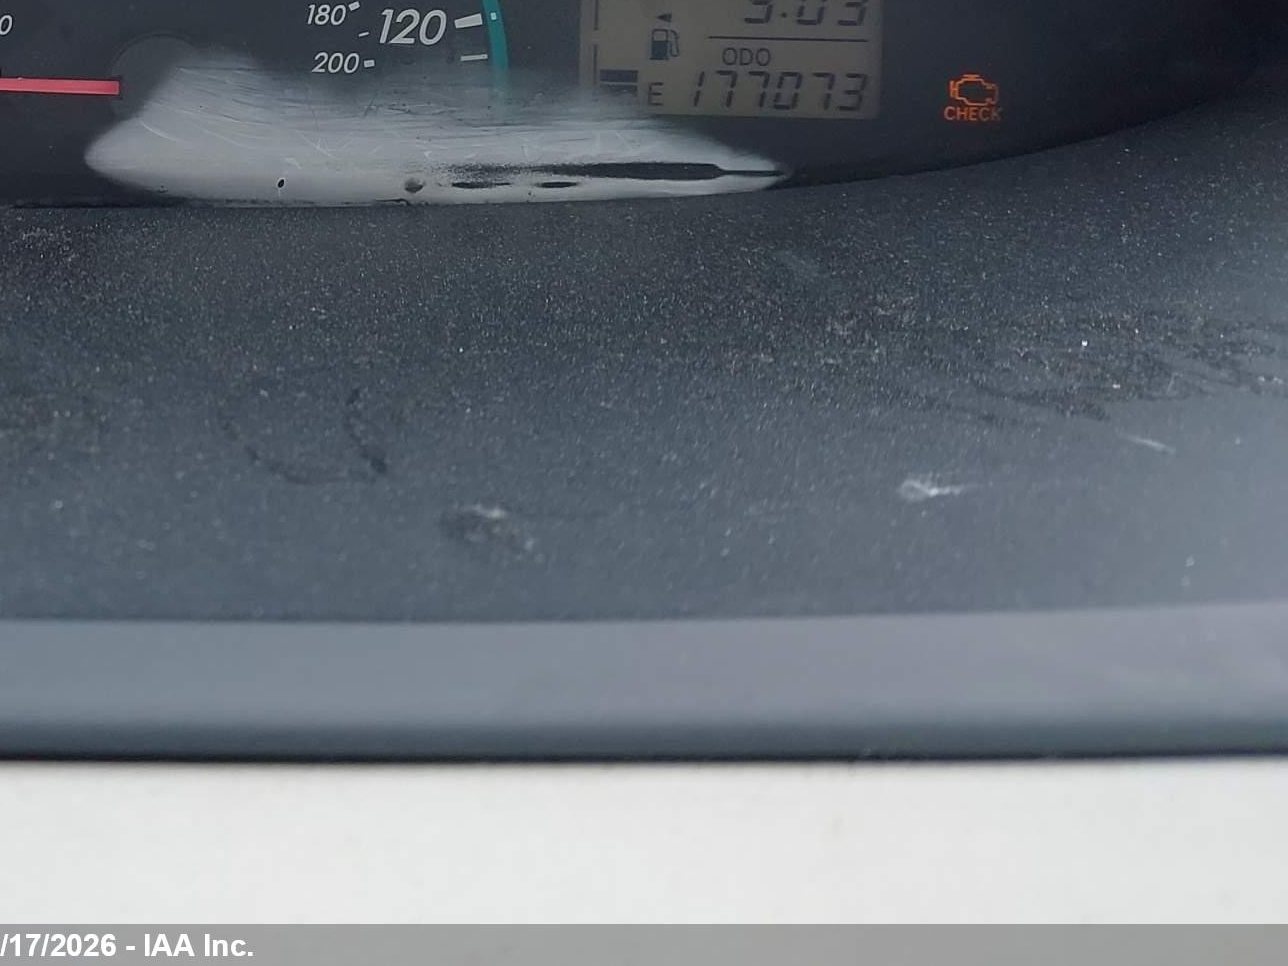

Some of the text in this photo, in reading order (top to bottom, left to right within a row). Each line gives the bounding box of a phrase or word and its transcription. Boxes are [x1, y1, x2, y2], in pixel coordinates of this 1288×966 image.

[306, 4, 346, 25] 180
[379, 9, 446, 45] 120
[311, 53, 359, 73] 200
[722, 49, 771, 66] ODO
[647, 82, 664, 107] E
[692, 72, 868, 112] 177073
[944, 106, 1001, 121] CHECK
